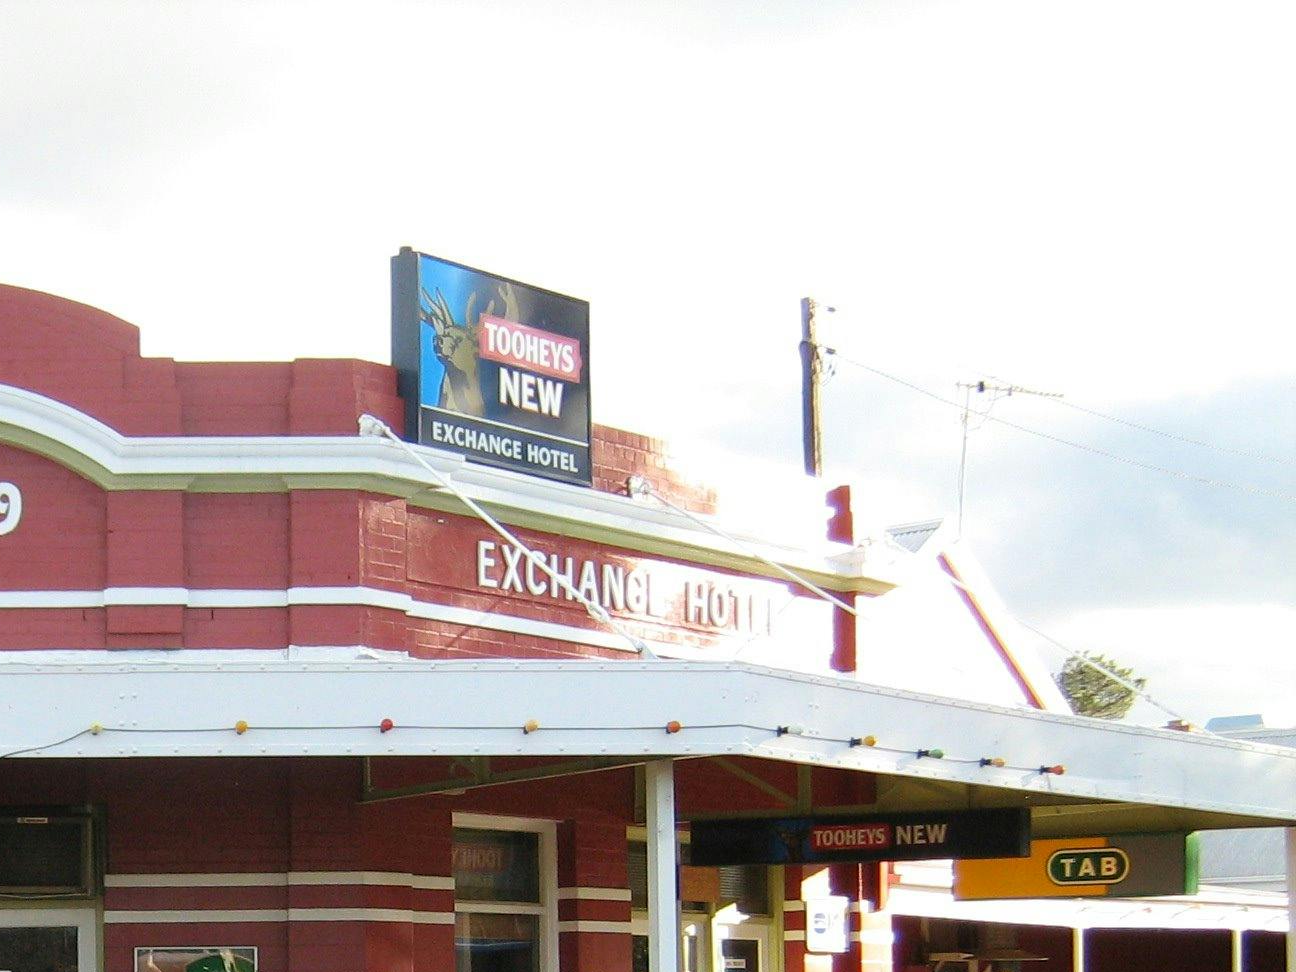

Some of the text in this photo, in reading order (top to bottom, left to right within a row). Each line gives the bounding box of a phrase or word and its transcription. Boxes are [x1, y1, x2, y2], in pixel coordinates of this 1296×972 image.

[484, 321, 576, 374] TOOHEYS
[499, 367, 564, 418] NEW
[432, 421, 579, 473] EXCHANGE HOTEL
[684, 579, 774, 637] HOT
[813, 824, 948, 847] TOOHEYS NEW
[1060, 856, 1118, 879] TAB
